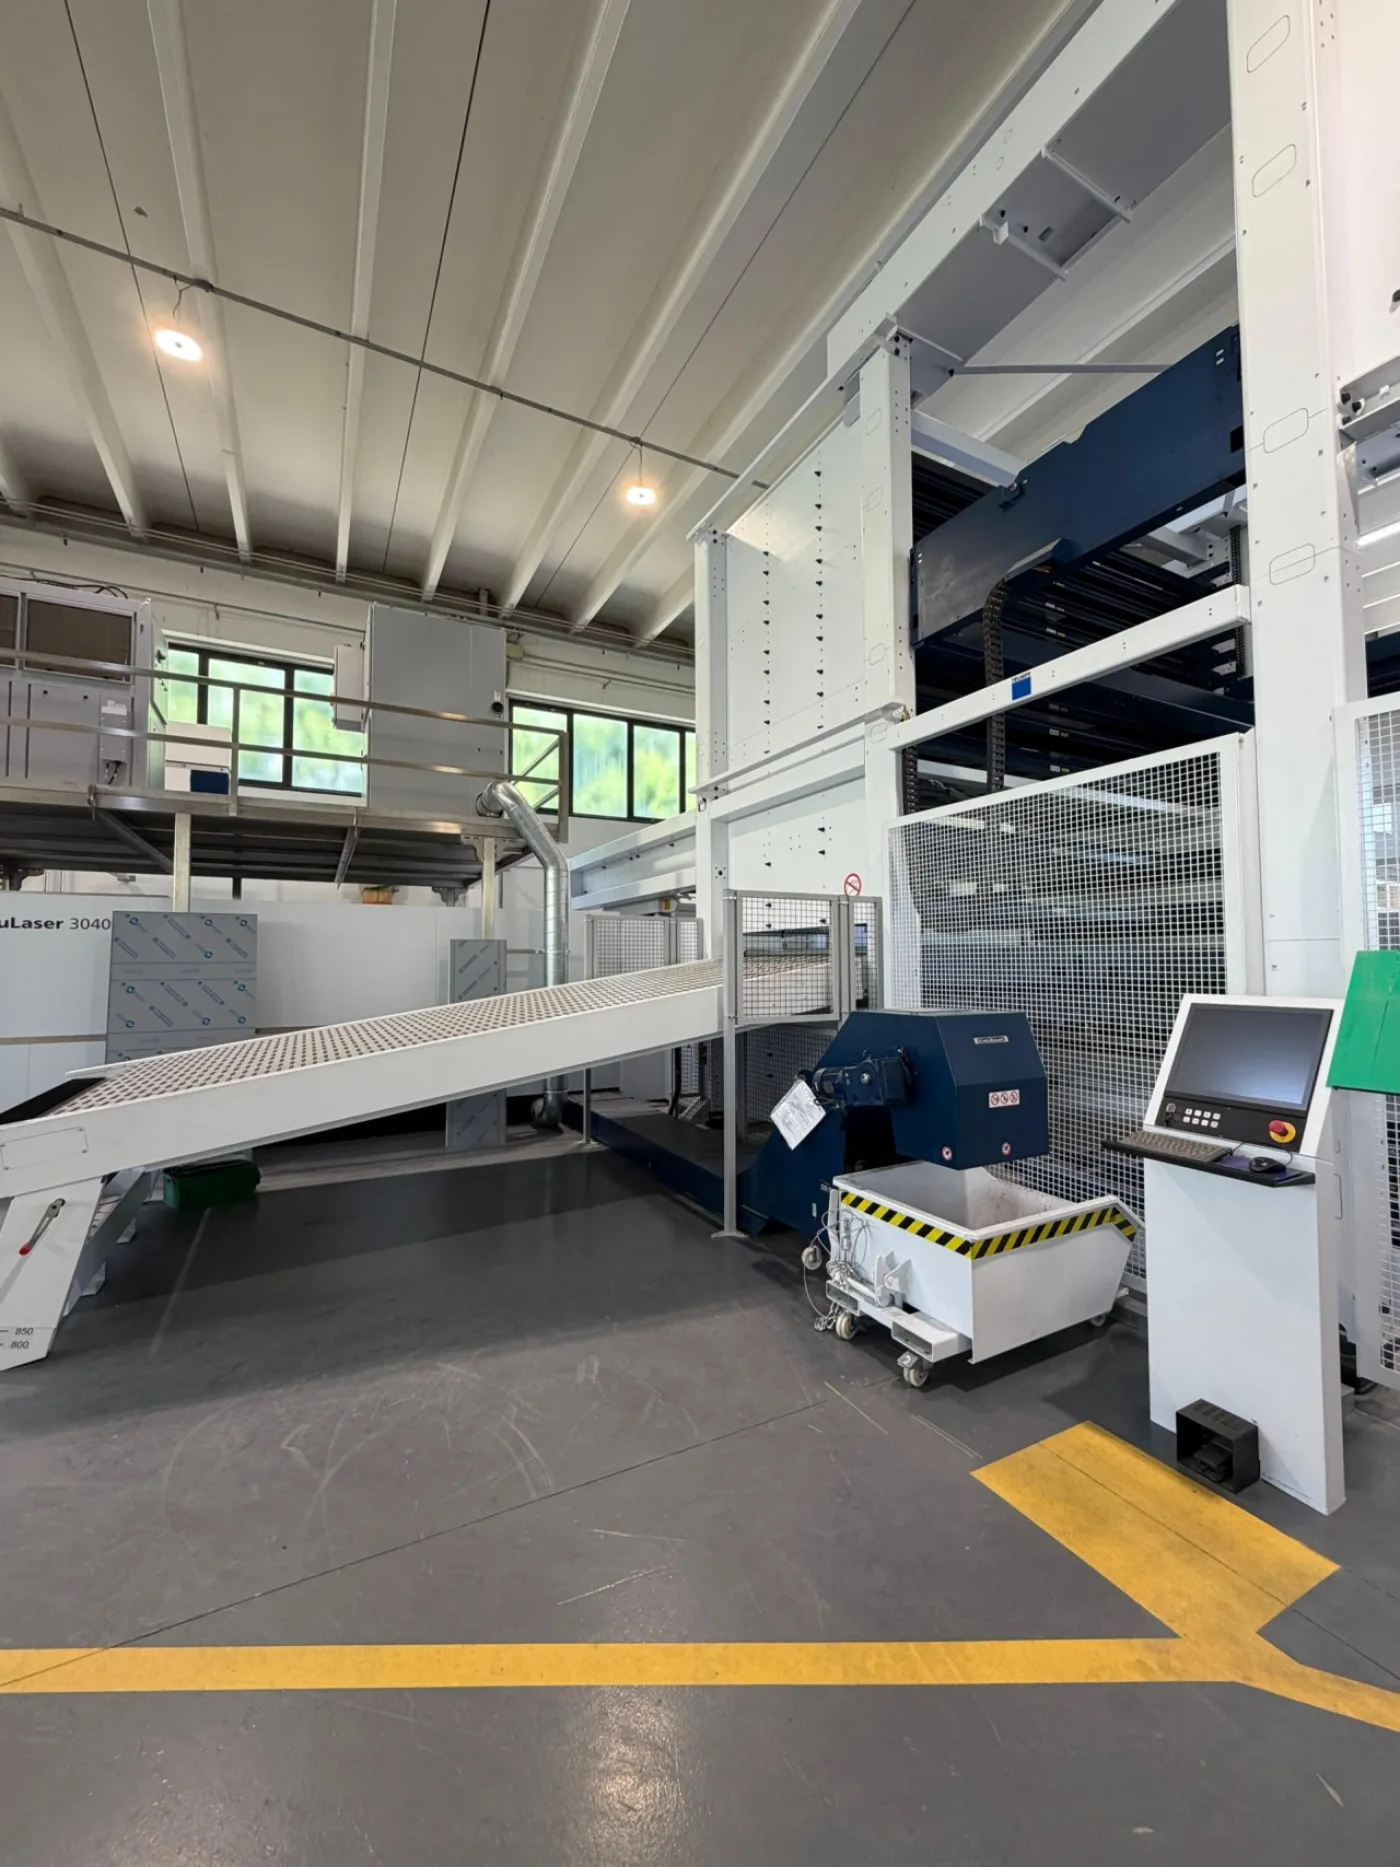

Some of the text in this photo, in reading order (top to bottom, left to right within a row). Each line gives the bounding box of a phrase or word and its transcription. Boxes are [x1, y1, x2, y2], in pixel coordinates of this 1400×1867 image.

[0, 917, 111, 930] uLaser 3040
[15, 1327, 34, 1336] 850
[11, 1340, 30, 1349] 800
